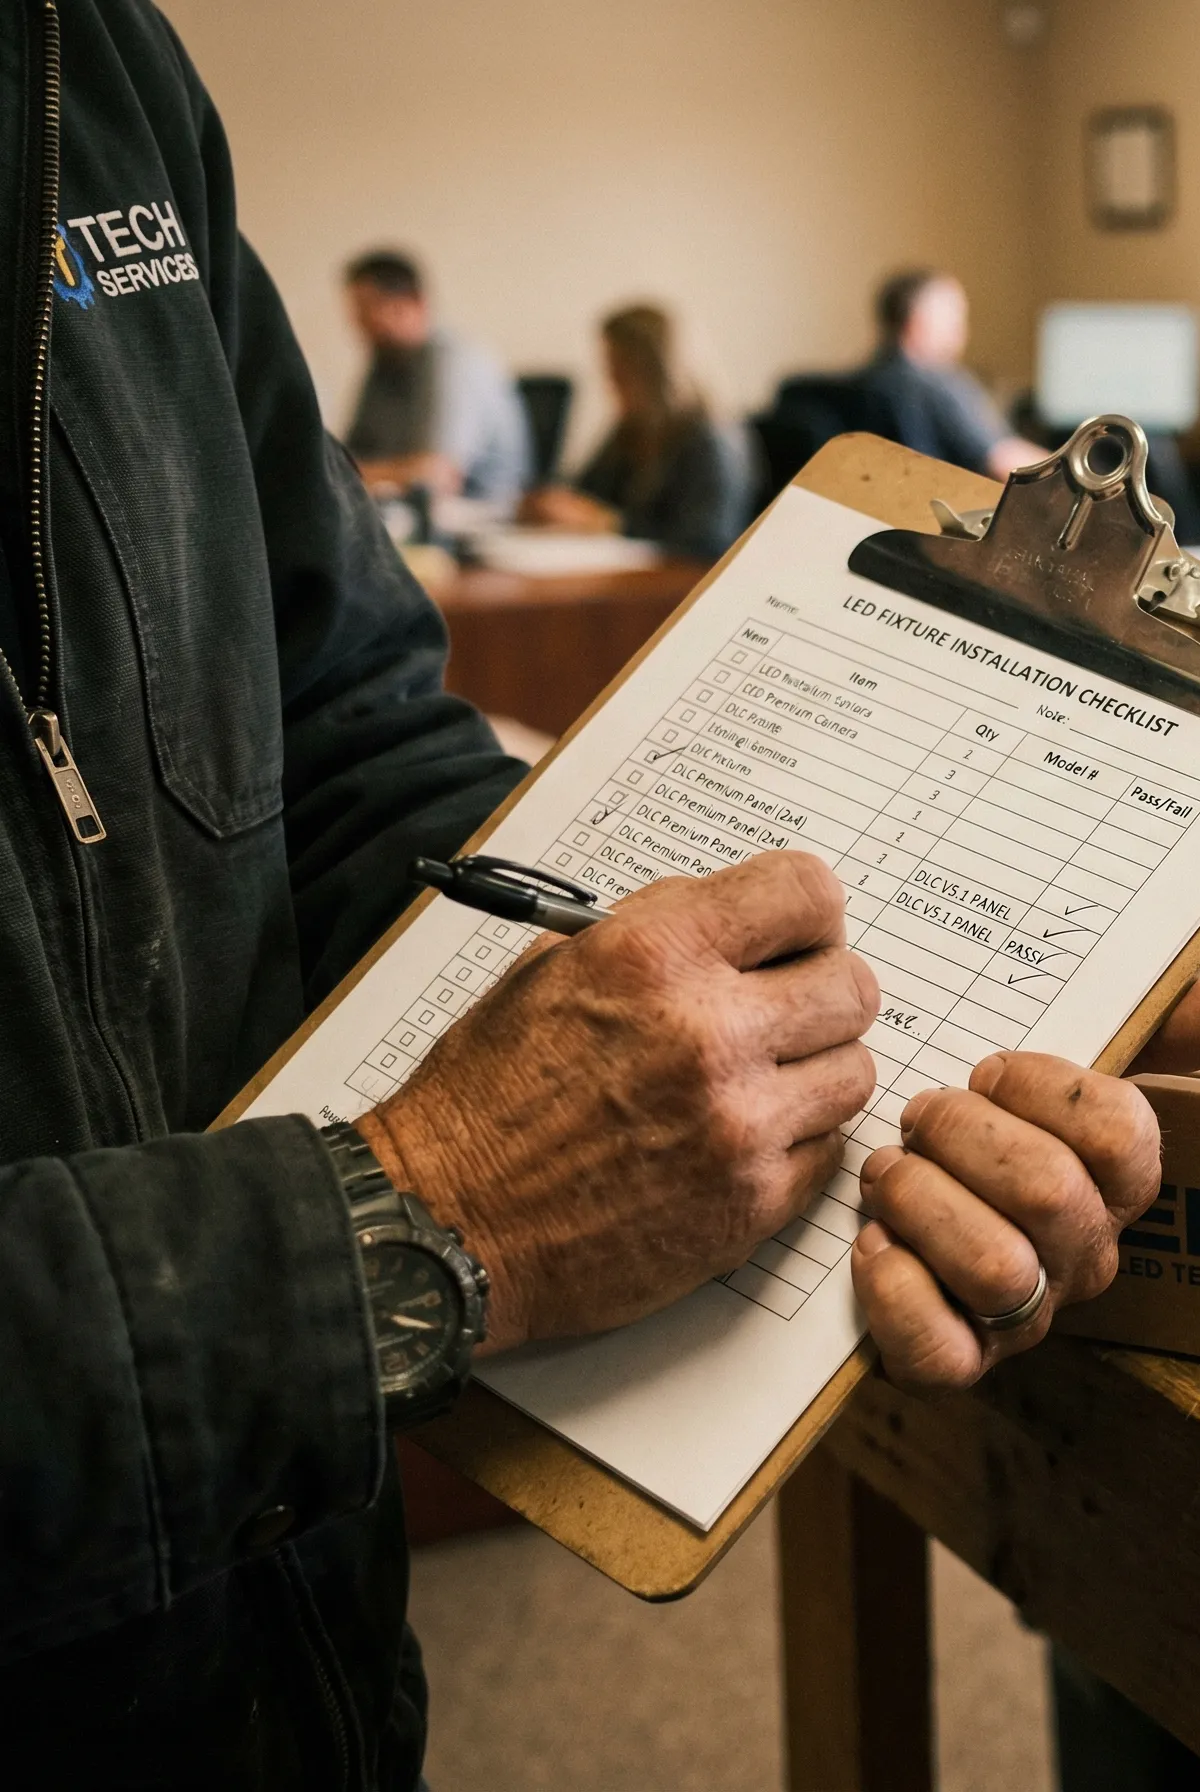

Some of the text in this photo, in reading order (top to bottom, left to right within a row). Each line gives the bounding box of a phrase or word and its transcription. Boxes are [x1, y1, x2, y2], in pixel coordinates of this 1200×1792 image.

[67, 200, 186, 263] TECH
[96, 252, 199, 297] SERVICES
[842, 596, 1179, 736] LED FIXTURE INSTALLATION CHECKLIST
[975, 724, 1000, 742] Qty
[671, 763, 696, 780] DLC
[695, 772, 743, 804] Premium
[744, 794, 779, 816] Panel
[1043, 751, 1100, 781] Model #
[637, 804, 661, 821] DLC
[655, 784, 679, 801] DLC
[678, 793, 726, 823] Premium
[727, 815, 761, 838] Panel
[1130, 786, 1193, 819] Pass/Fail
[600, 846, 664, 882] DLC Premiu
[619, 825, 715, 877] DLC Premium Pan
[582, 867, 635, 897] DLC Prem
[914, 870, 1012, 921] DLC V5.1 PANEL
[896, 891, 993, 943] DLC V5.1 PANEL
